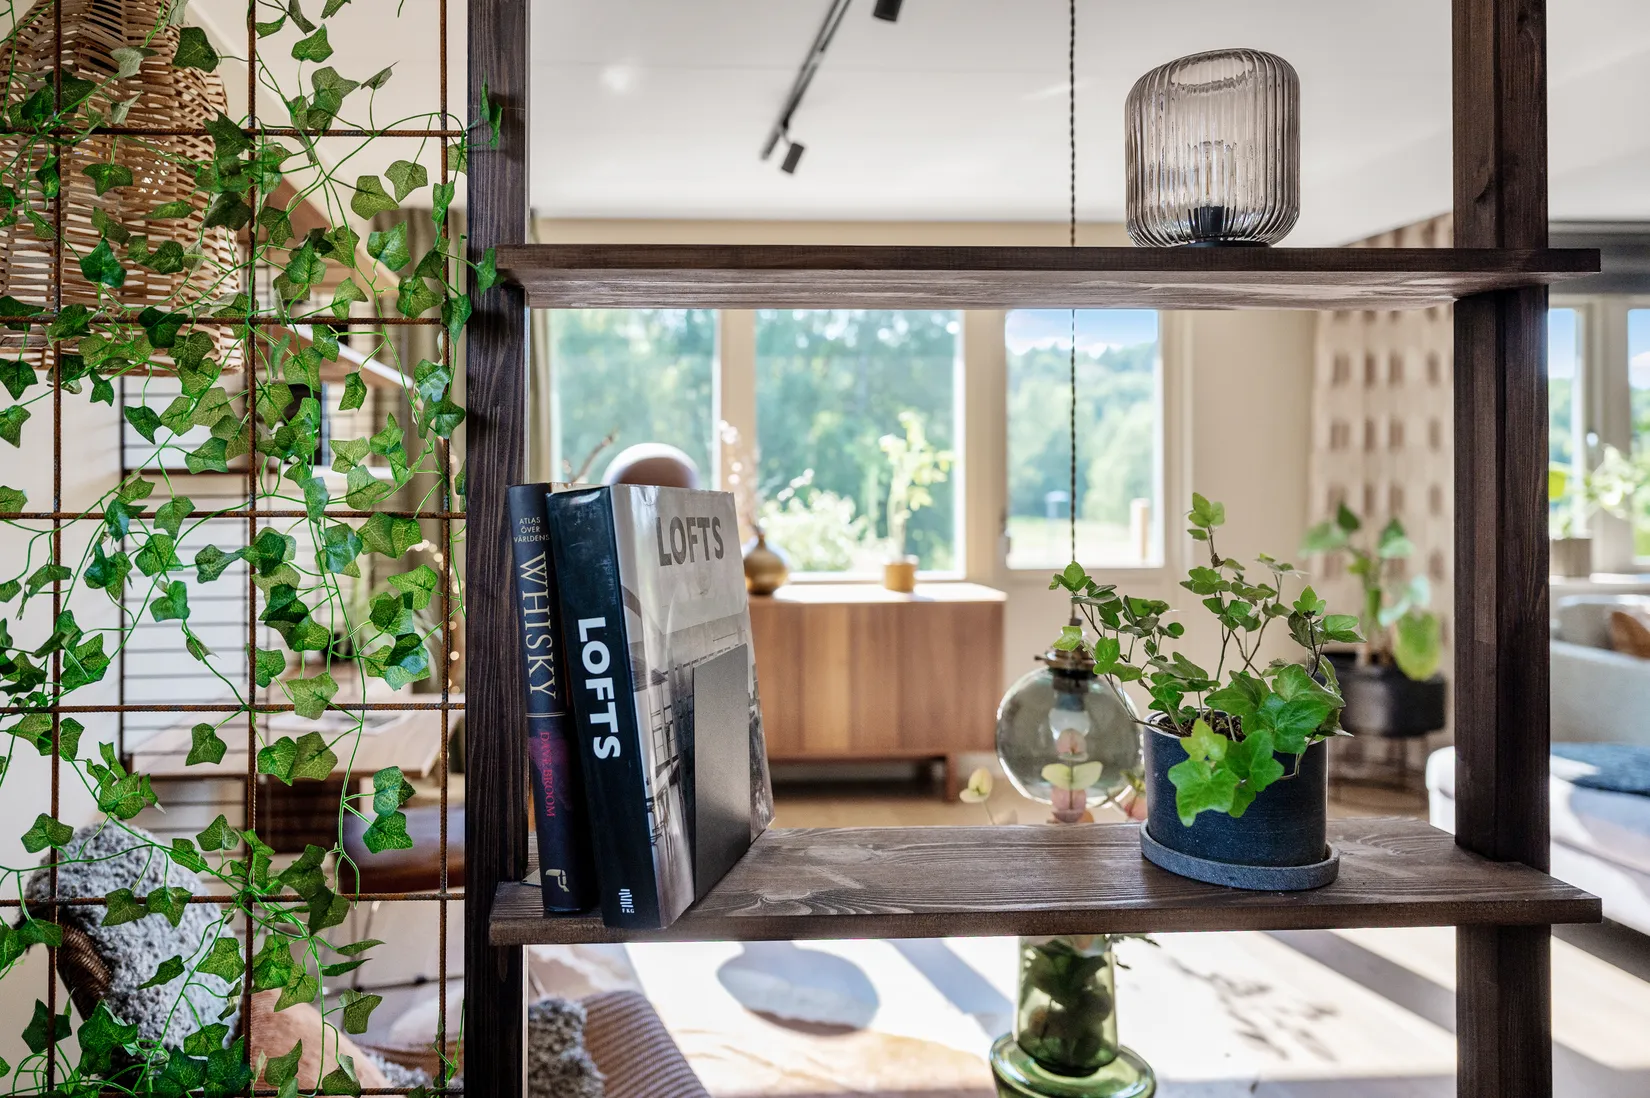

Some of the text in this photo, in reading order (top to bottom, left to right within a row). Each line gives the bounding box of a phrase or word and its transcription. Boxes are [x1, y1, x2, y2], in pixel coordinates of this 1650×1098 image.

[513, 534, 550, 543] VÄRLDENS
[519, 517, 541, 525] ATLAS
[520, 525, 540, 534] ÖVER
[656, 516, 724, 567] LOFTS
[520, 551, 556, 699] WHISKY
[578, 617, 621, 759] LOFTS
[541, 732, 556, 816] DAVE BROOM
